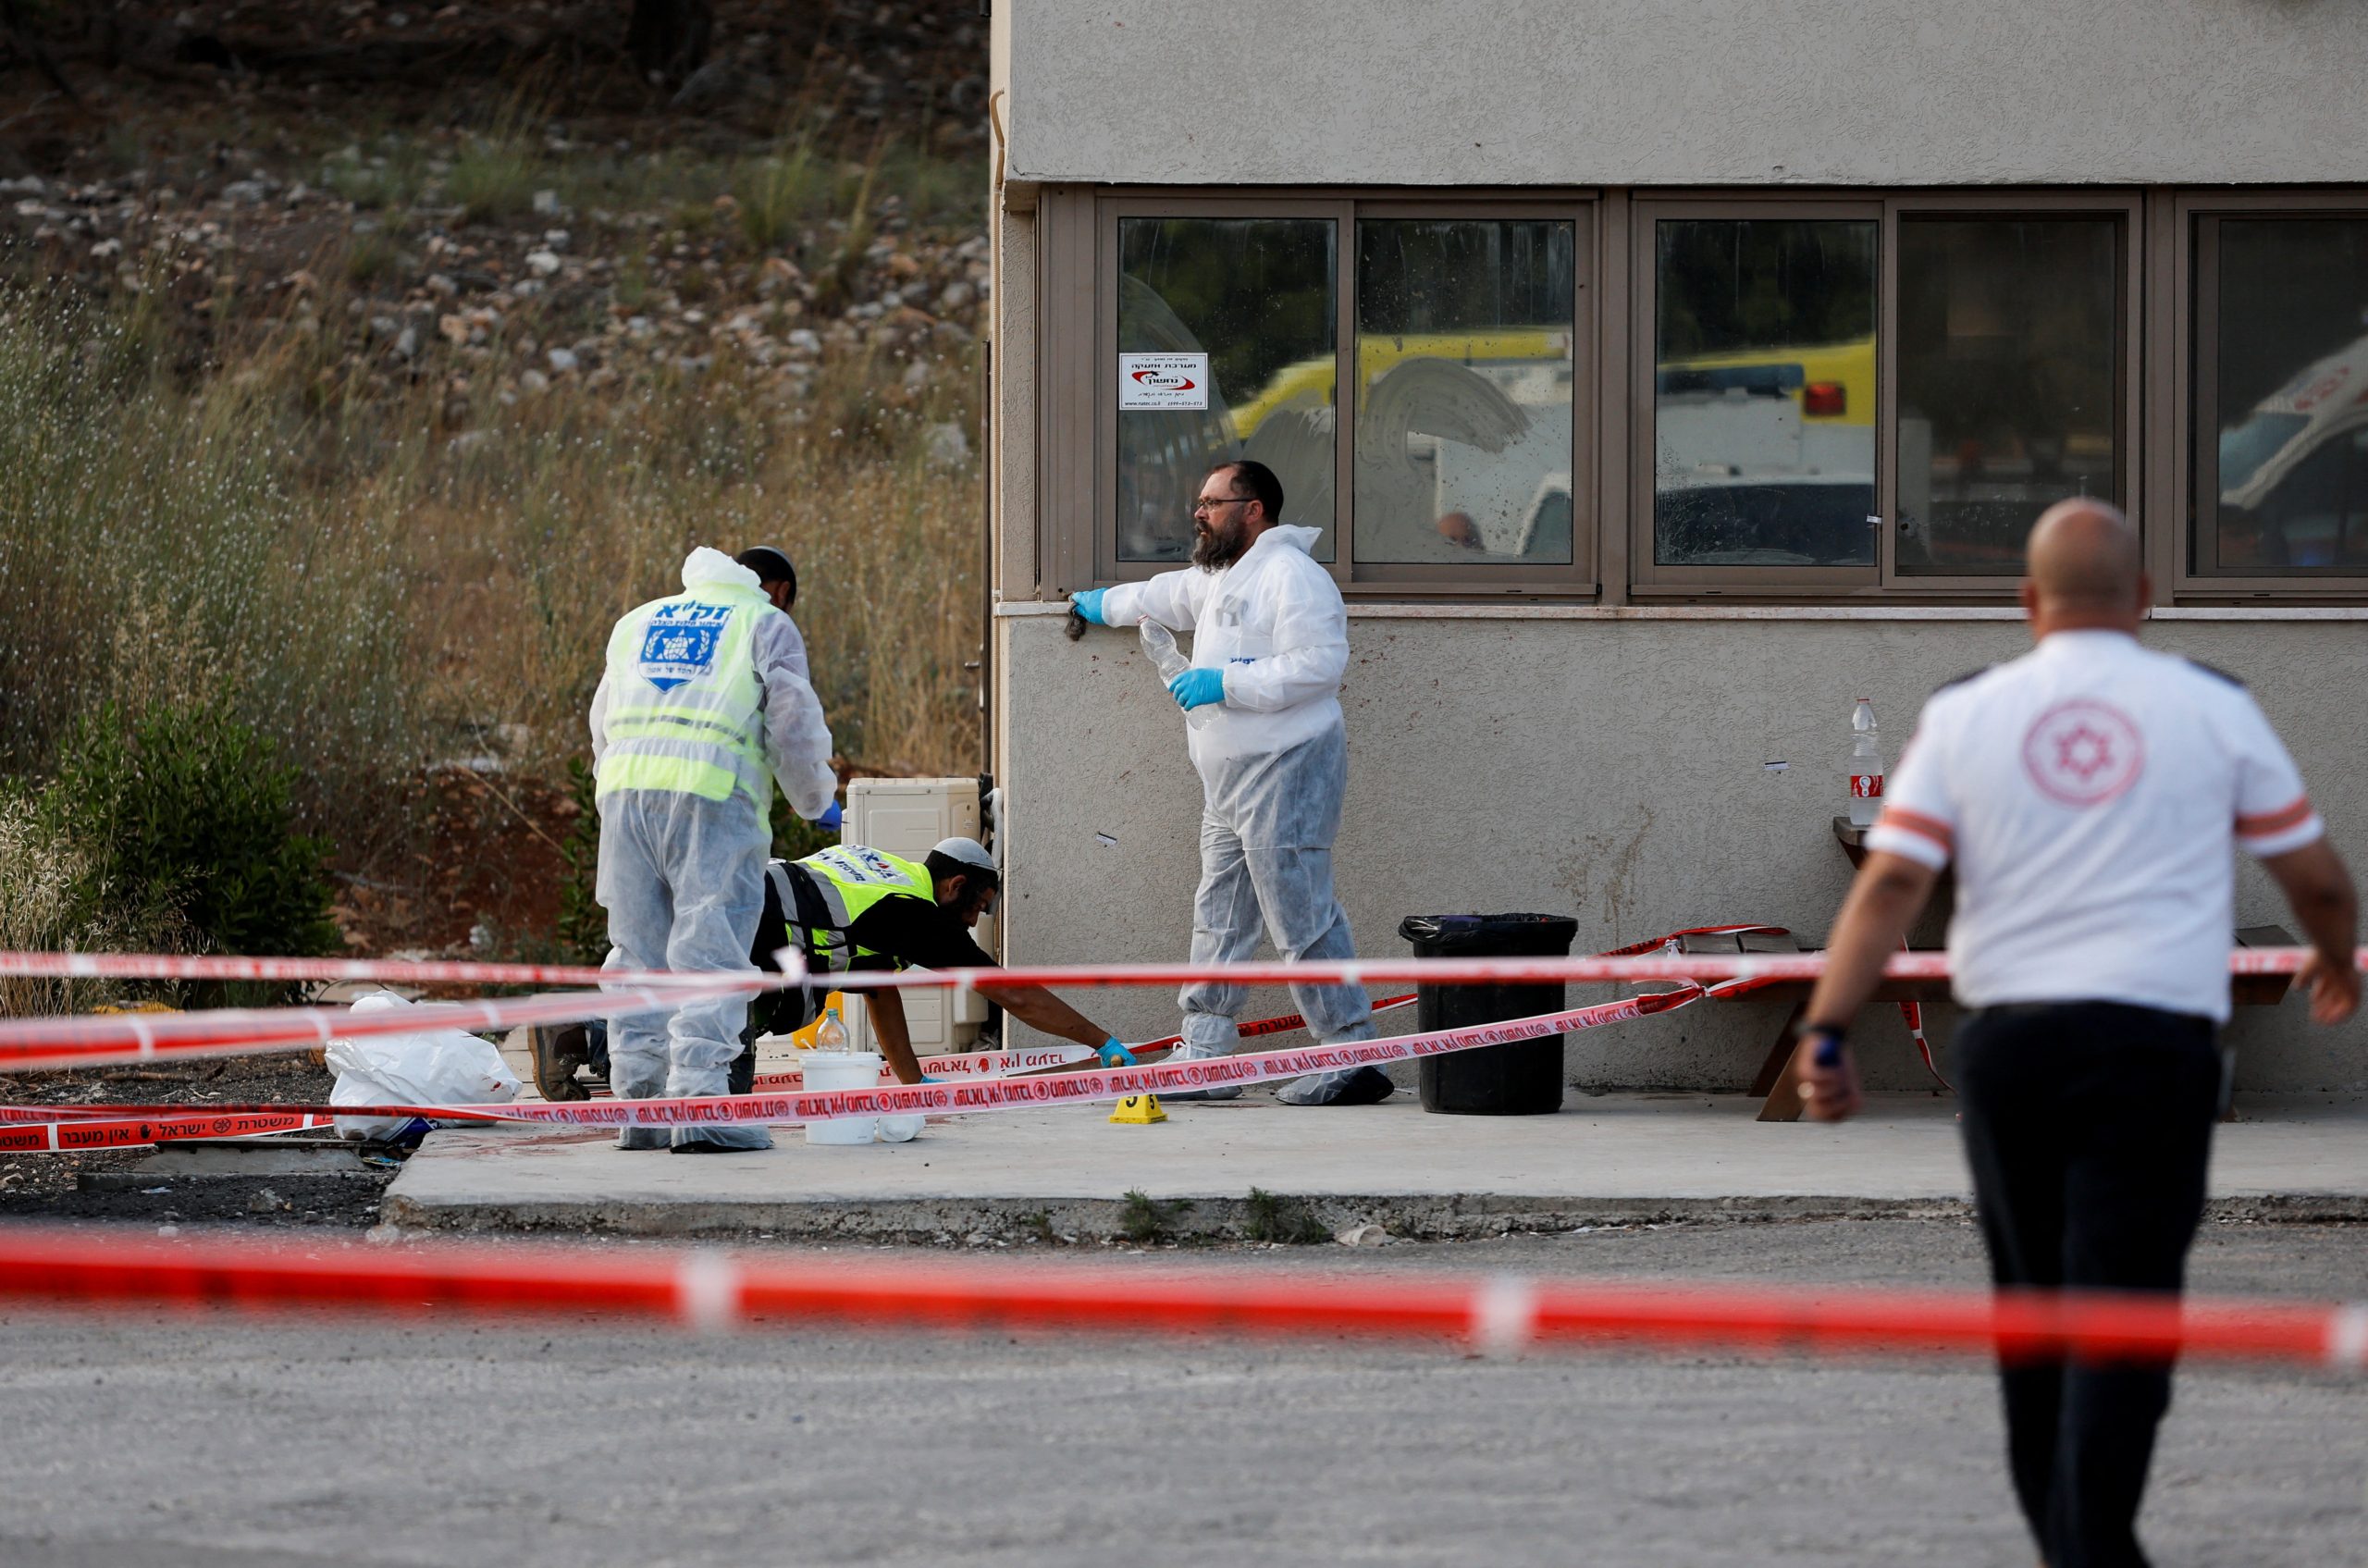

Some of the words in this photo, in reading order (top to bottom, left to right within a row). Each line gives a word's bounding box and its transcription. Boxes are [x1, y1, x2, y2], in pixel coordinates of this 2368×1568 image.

[1258, 1015, 1303, 1034] שטרת
[1000, 1053, 1020, 1068] אין
[1026, 1053, 1067, 1066] מעבר
[734, 1100, 774, 1120] משטרת
[894, 1091, 933, 1110] משטרת
[1050, 1079, 1090, 1098] משטרת
[1202, 1062, 1244, 1082] משטרת
[158, 1122, 206, 1137] ישראל
[237, 1117, 295, 1130] משטרת
[1, 1133, 40, 1147] משט
[64, 1130, 104, 1144] מעבר
[109, 1128, 130, 1143] אין
